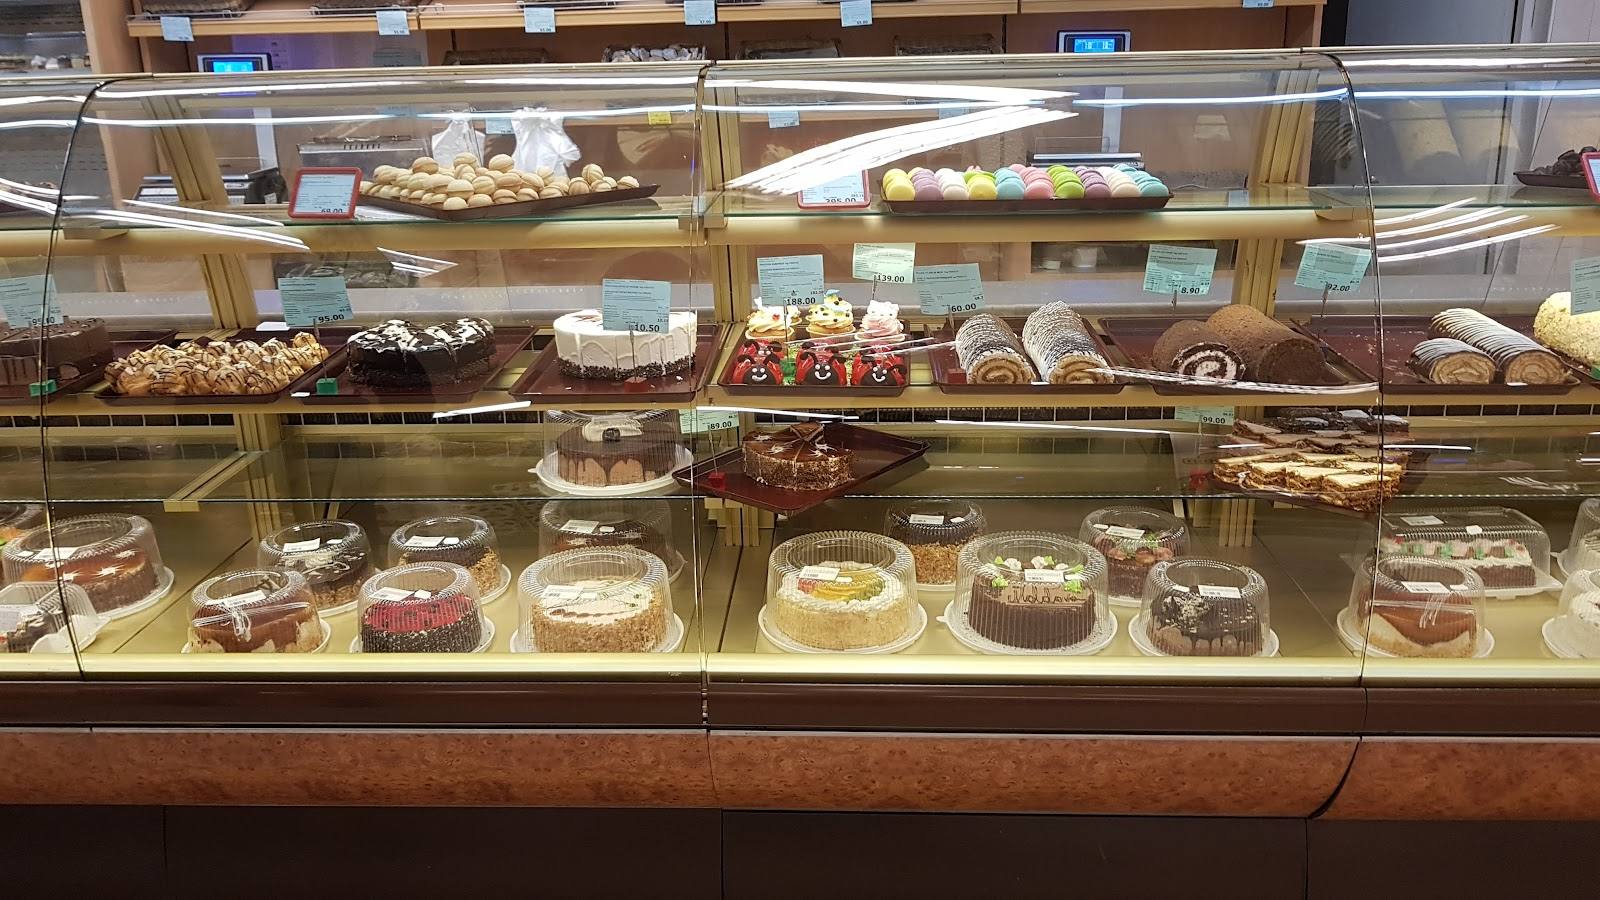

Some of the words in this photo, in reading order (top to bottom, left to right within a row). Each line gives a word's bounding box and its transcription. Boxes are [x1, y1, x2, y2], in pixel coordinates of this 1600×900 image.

[876, 274, 905, 283] 139.00
[786, 297, 816, 306] 188.00
[951, 303, 977, 312] 60.00
[318, 314, 345, 323] 95.00
[634, 323, 660, 332] 10.50
[1202, 416, 1226, 424] 99.00
[710, 421, 732, 430] 89.00
